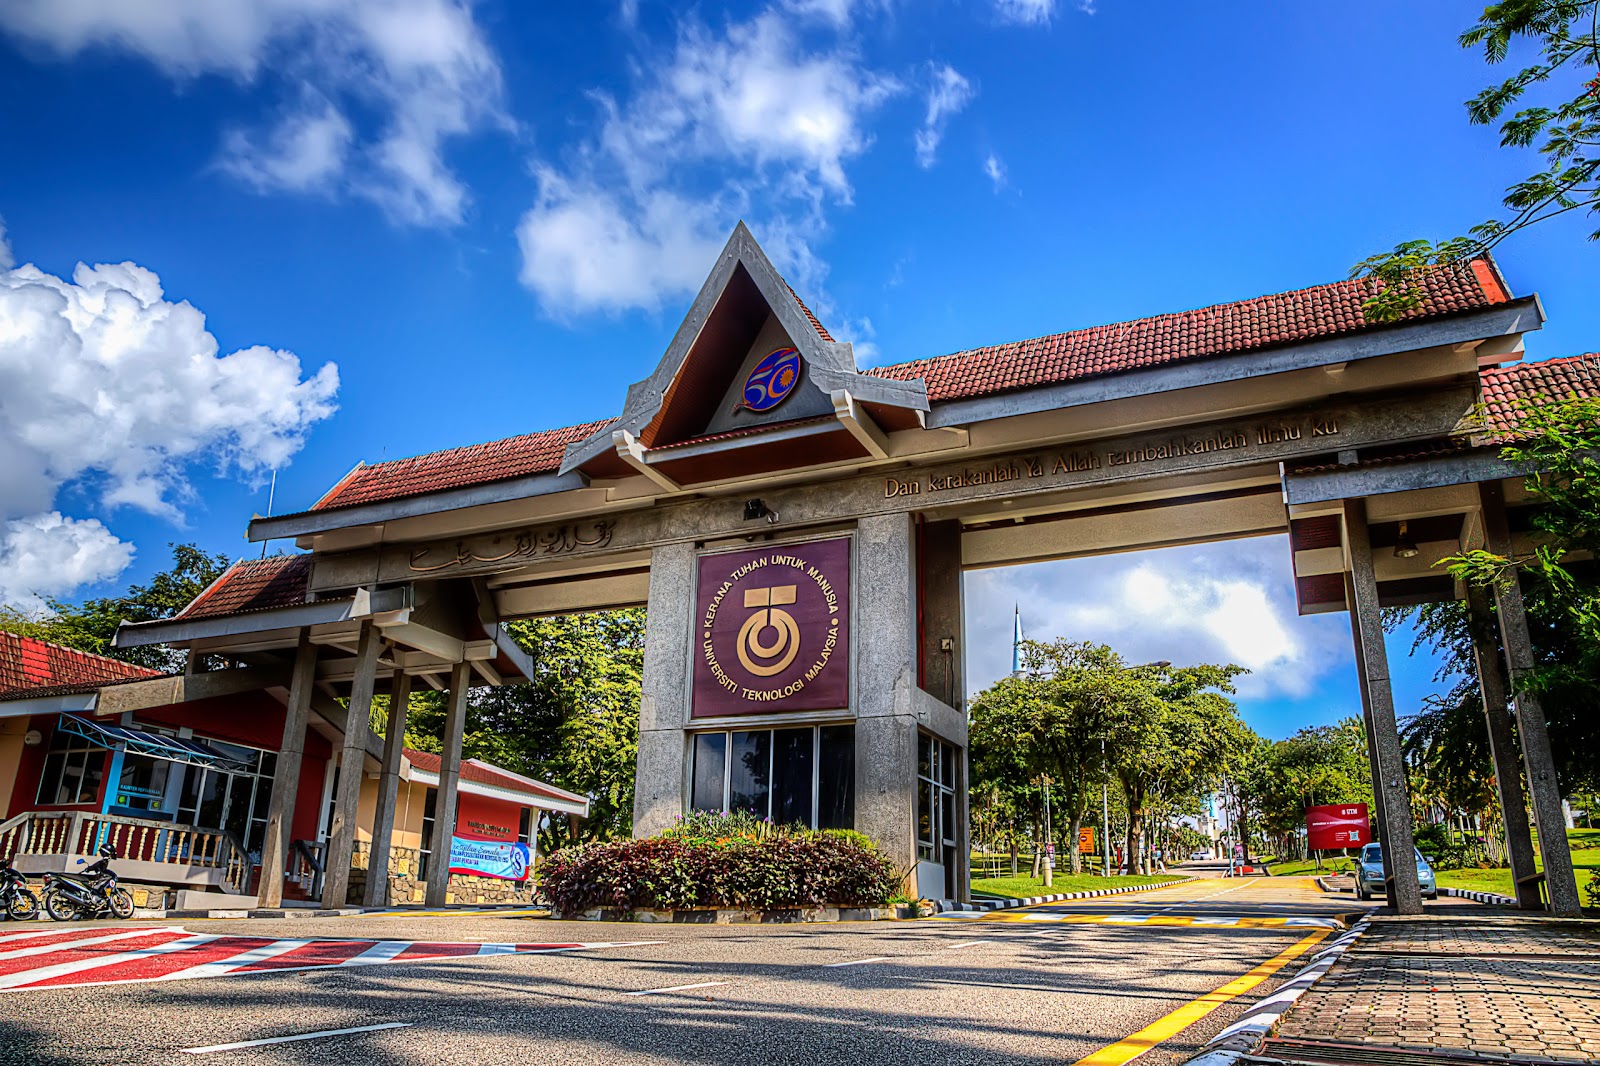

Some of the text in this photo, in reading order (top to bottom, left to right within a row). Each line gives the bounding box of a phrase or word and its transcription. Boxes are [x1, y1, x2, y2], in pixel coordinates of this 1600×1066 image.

[884, 478, 919, 499] Dan
[928, 463, 1019, 492] katakanlah
[1023, 458, 1043, 478] Ya
[1052, 451, 1100, 475] Allah
[1107, 430, 1247, 467] tambahkanlah
[1311, 418, 1339, 437] ku
[703, 555, 839, 628] KERANA TUHAN UNTUK MANUSIA
[703, 627, 839, 701] UNIVERSITI TEKNOLOGI MALAYSIA
